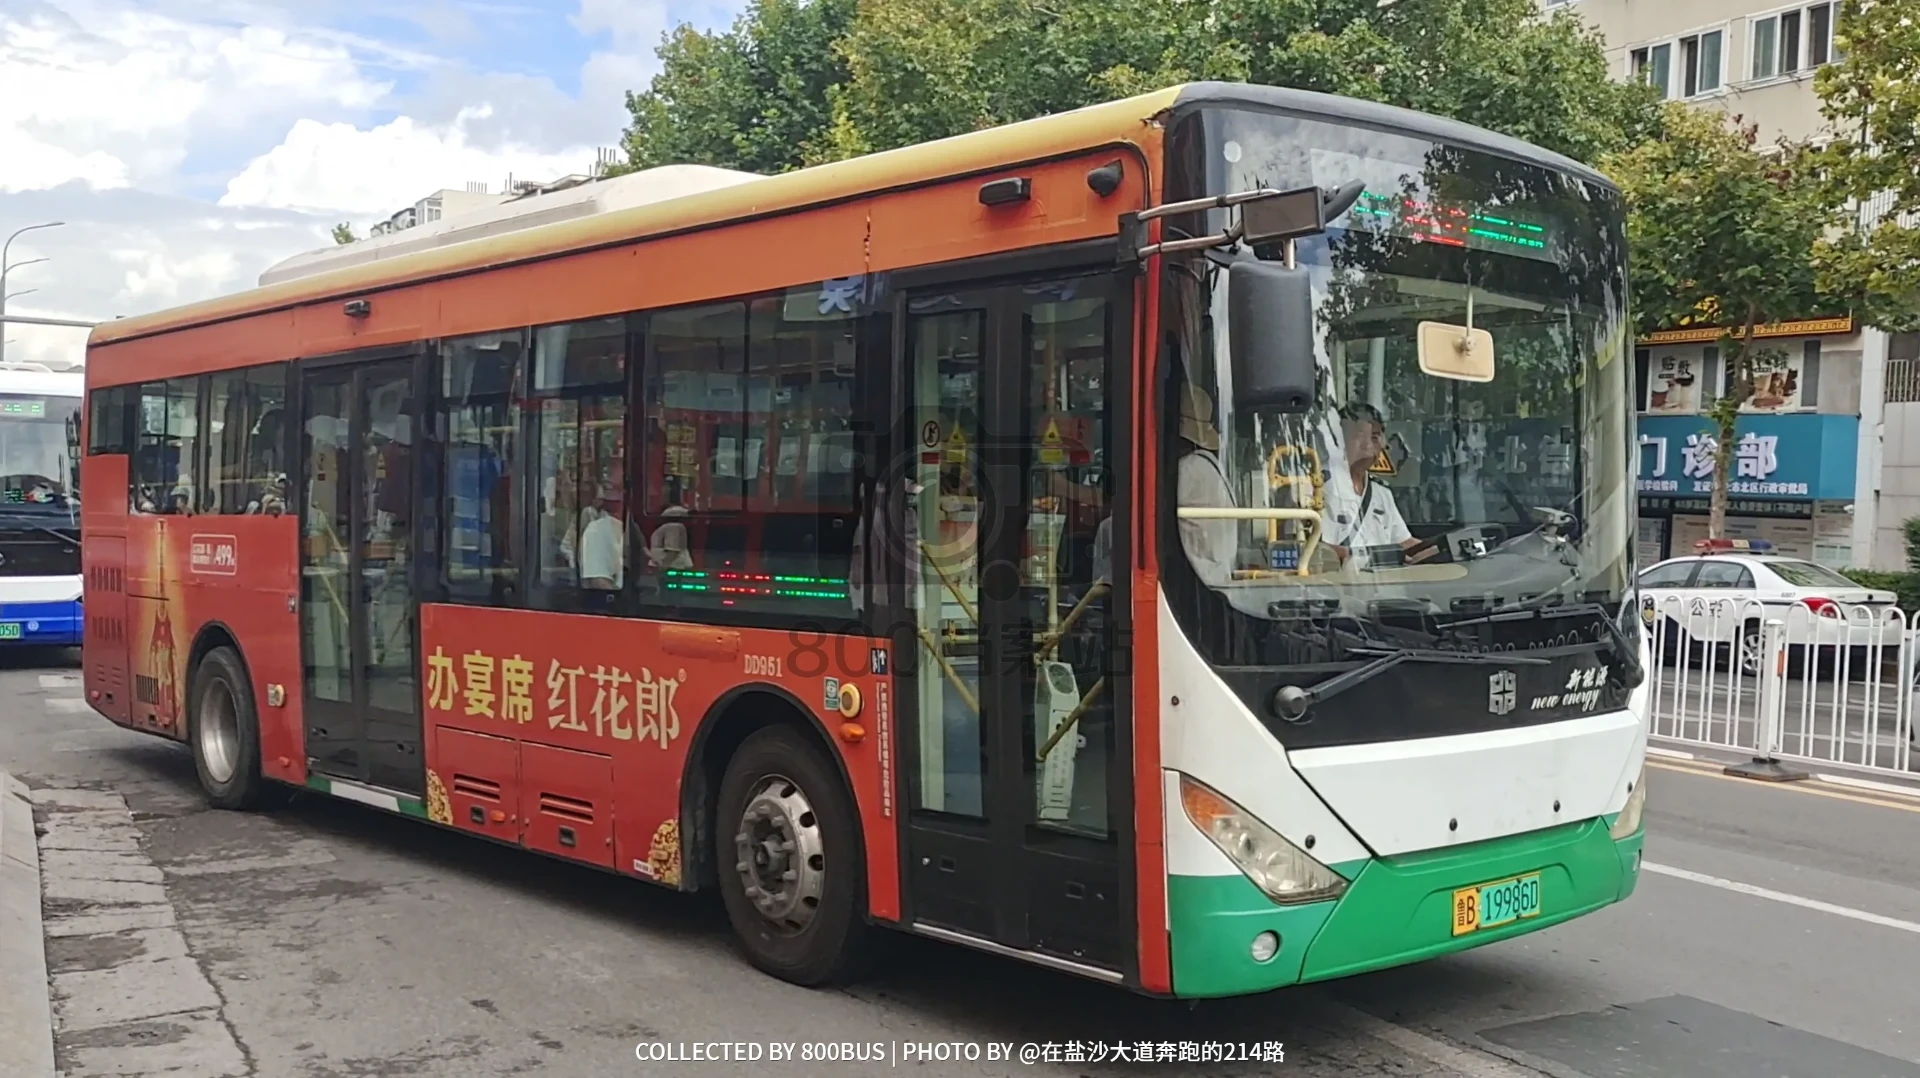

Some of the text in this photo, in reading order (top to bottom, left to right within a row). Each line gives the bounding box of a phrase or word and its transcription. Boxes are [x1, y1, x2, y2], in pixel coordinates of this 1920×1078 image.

[1636, 432, 1779, 480] 门诊部
[1691, 600, 1723, 619] 公安
[744, 653, 783, 677] DD951
[1565, 666, 1608, 693] 新能源
[427, 645, 681, 750] 办宴席 红花郎
[1531, 688, 1601, 712] new energy
